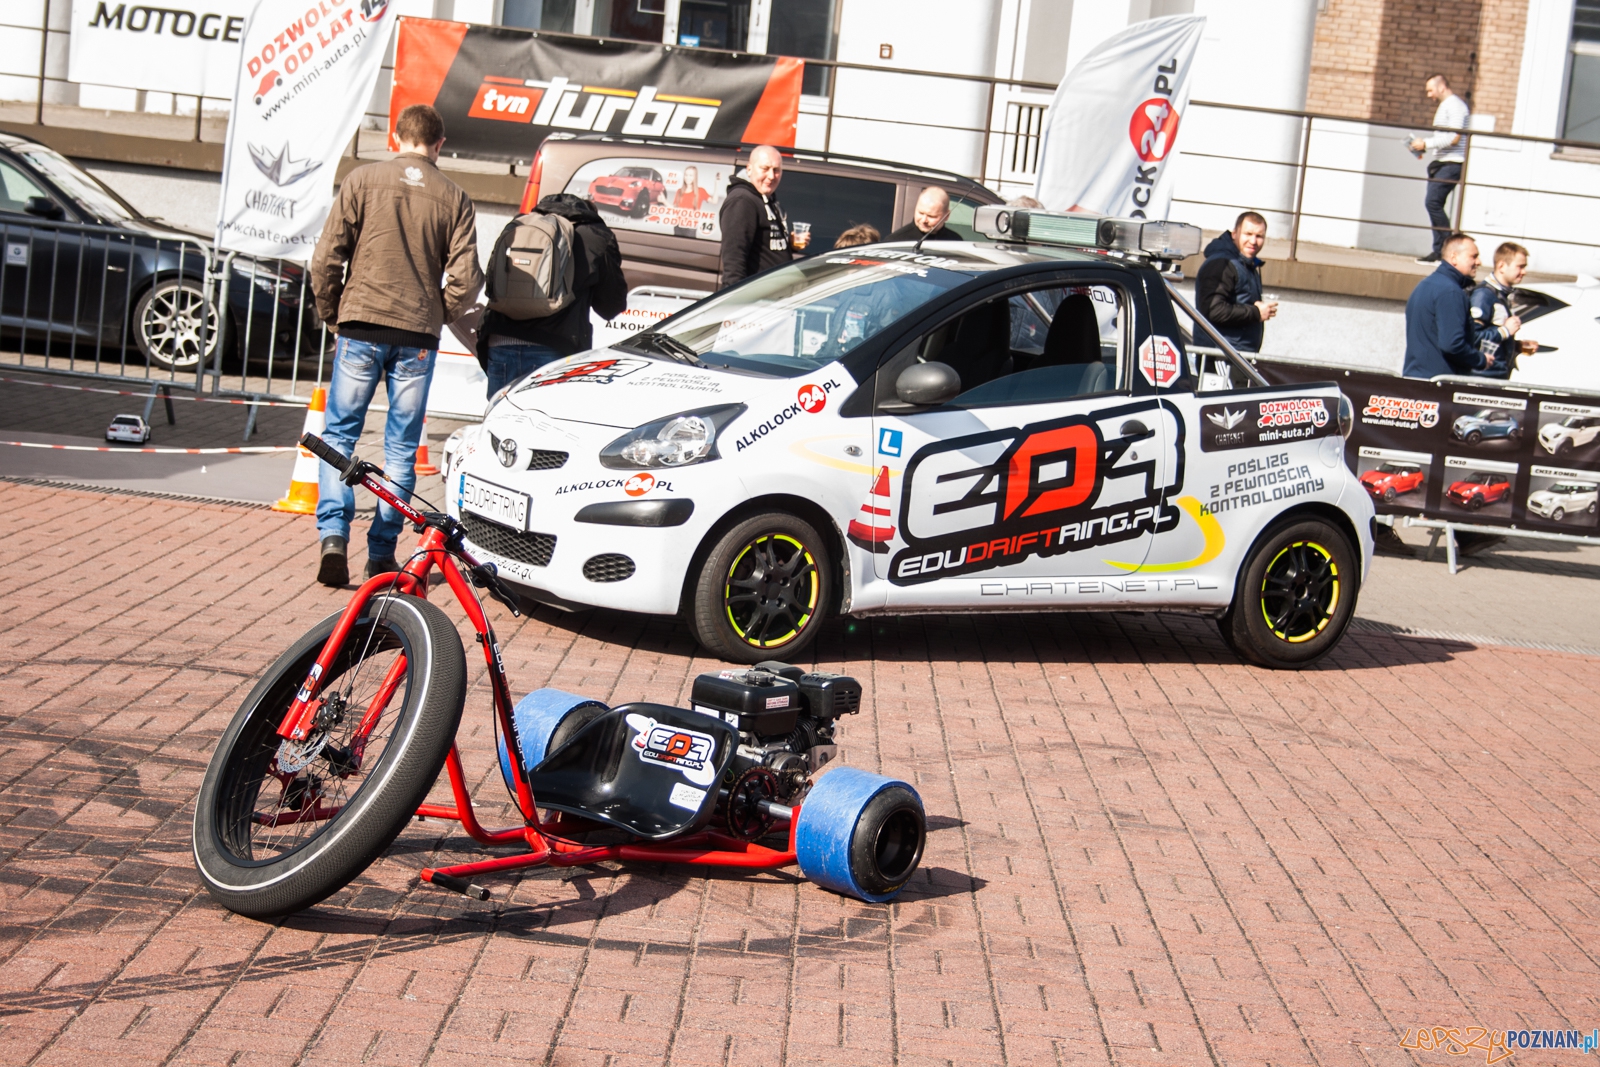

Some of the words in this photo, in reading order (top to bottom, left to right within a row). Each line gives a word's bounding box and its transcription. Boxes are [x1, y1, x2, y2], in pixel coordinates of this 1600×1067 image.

[284, 42, 314, 75] OD
[317, 8, 353, 49] LAT
[262, 27, 367, 121] www.mini-auta.pl
[1154, 58, 1177, 96] PL
[482, 92, 530, 115] tvn
[650, 206, 716, 221] DOZWOLONE
[662, 217, 679, 227] OD
[681, 219, 699, 229] LAT
[702, 222, 715, 232] 14
[605, 321, 653, 332] ALKOH
[1260, 400, 1323, 414] DOZWOLONE
[1370, 397, 1437, 410] DOZWOLONE
[735, 402, 802, 452] ALKOLOCK
[822, 378, 841, 394] PL
[1276, 414, 1292, 425] OD
[1295, 411, 1312, 422] LAT
[1314, 411, 1326, 423] 14
[1361, 417, 1419, 429] www.mini-auta.pl
[1383, 408, 1399, 417] OD
[1401, 410, 1420, 419] LAT
[1423, 413, 1436, 423] 14
[1258, 425, 1315, 442] mini-auta.pl
[880, 431, 900, 458] L
[1228, 452, 1289, 478] POŚLIZG
[555, 480, 625, 497] ALKOLOCK
[656, 480, 675, 493] PL
[1200, 478, 1325, 517] KONTROLOWANY
[897, 508, 1173, 578] EDUDRIFTRING.PL
[980, 578, 1218, 596] CHATENET.PL
